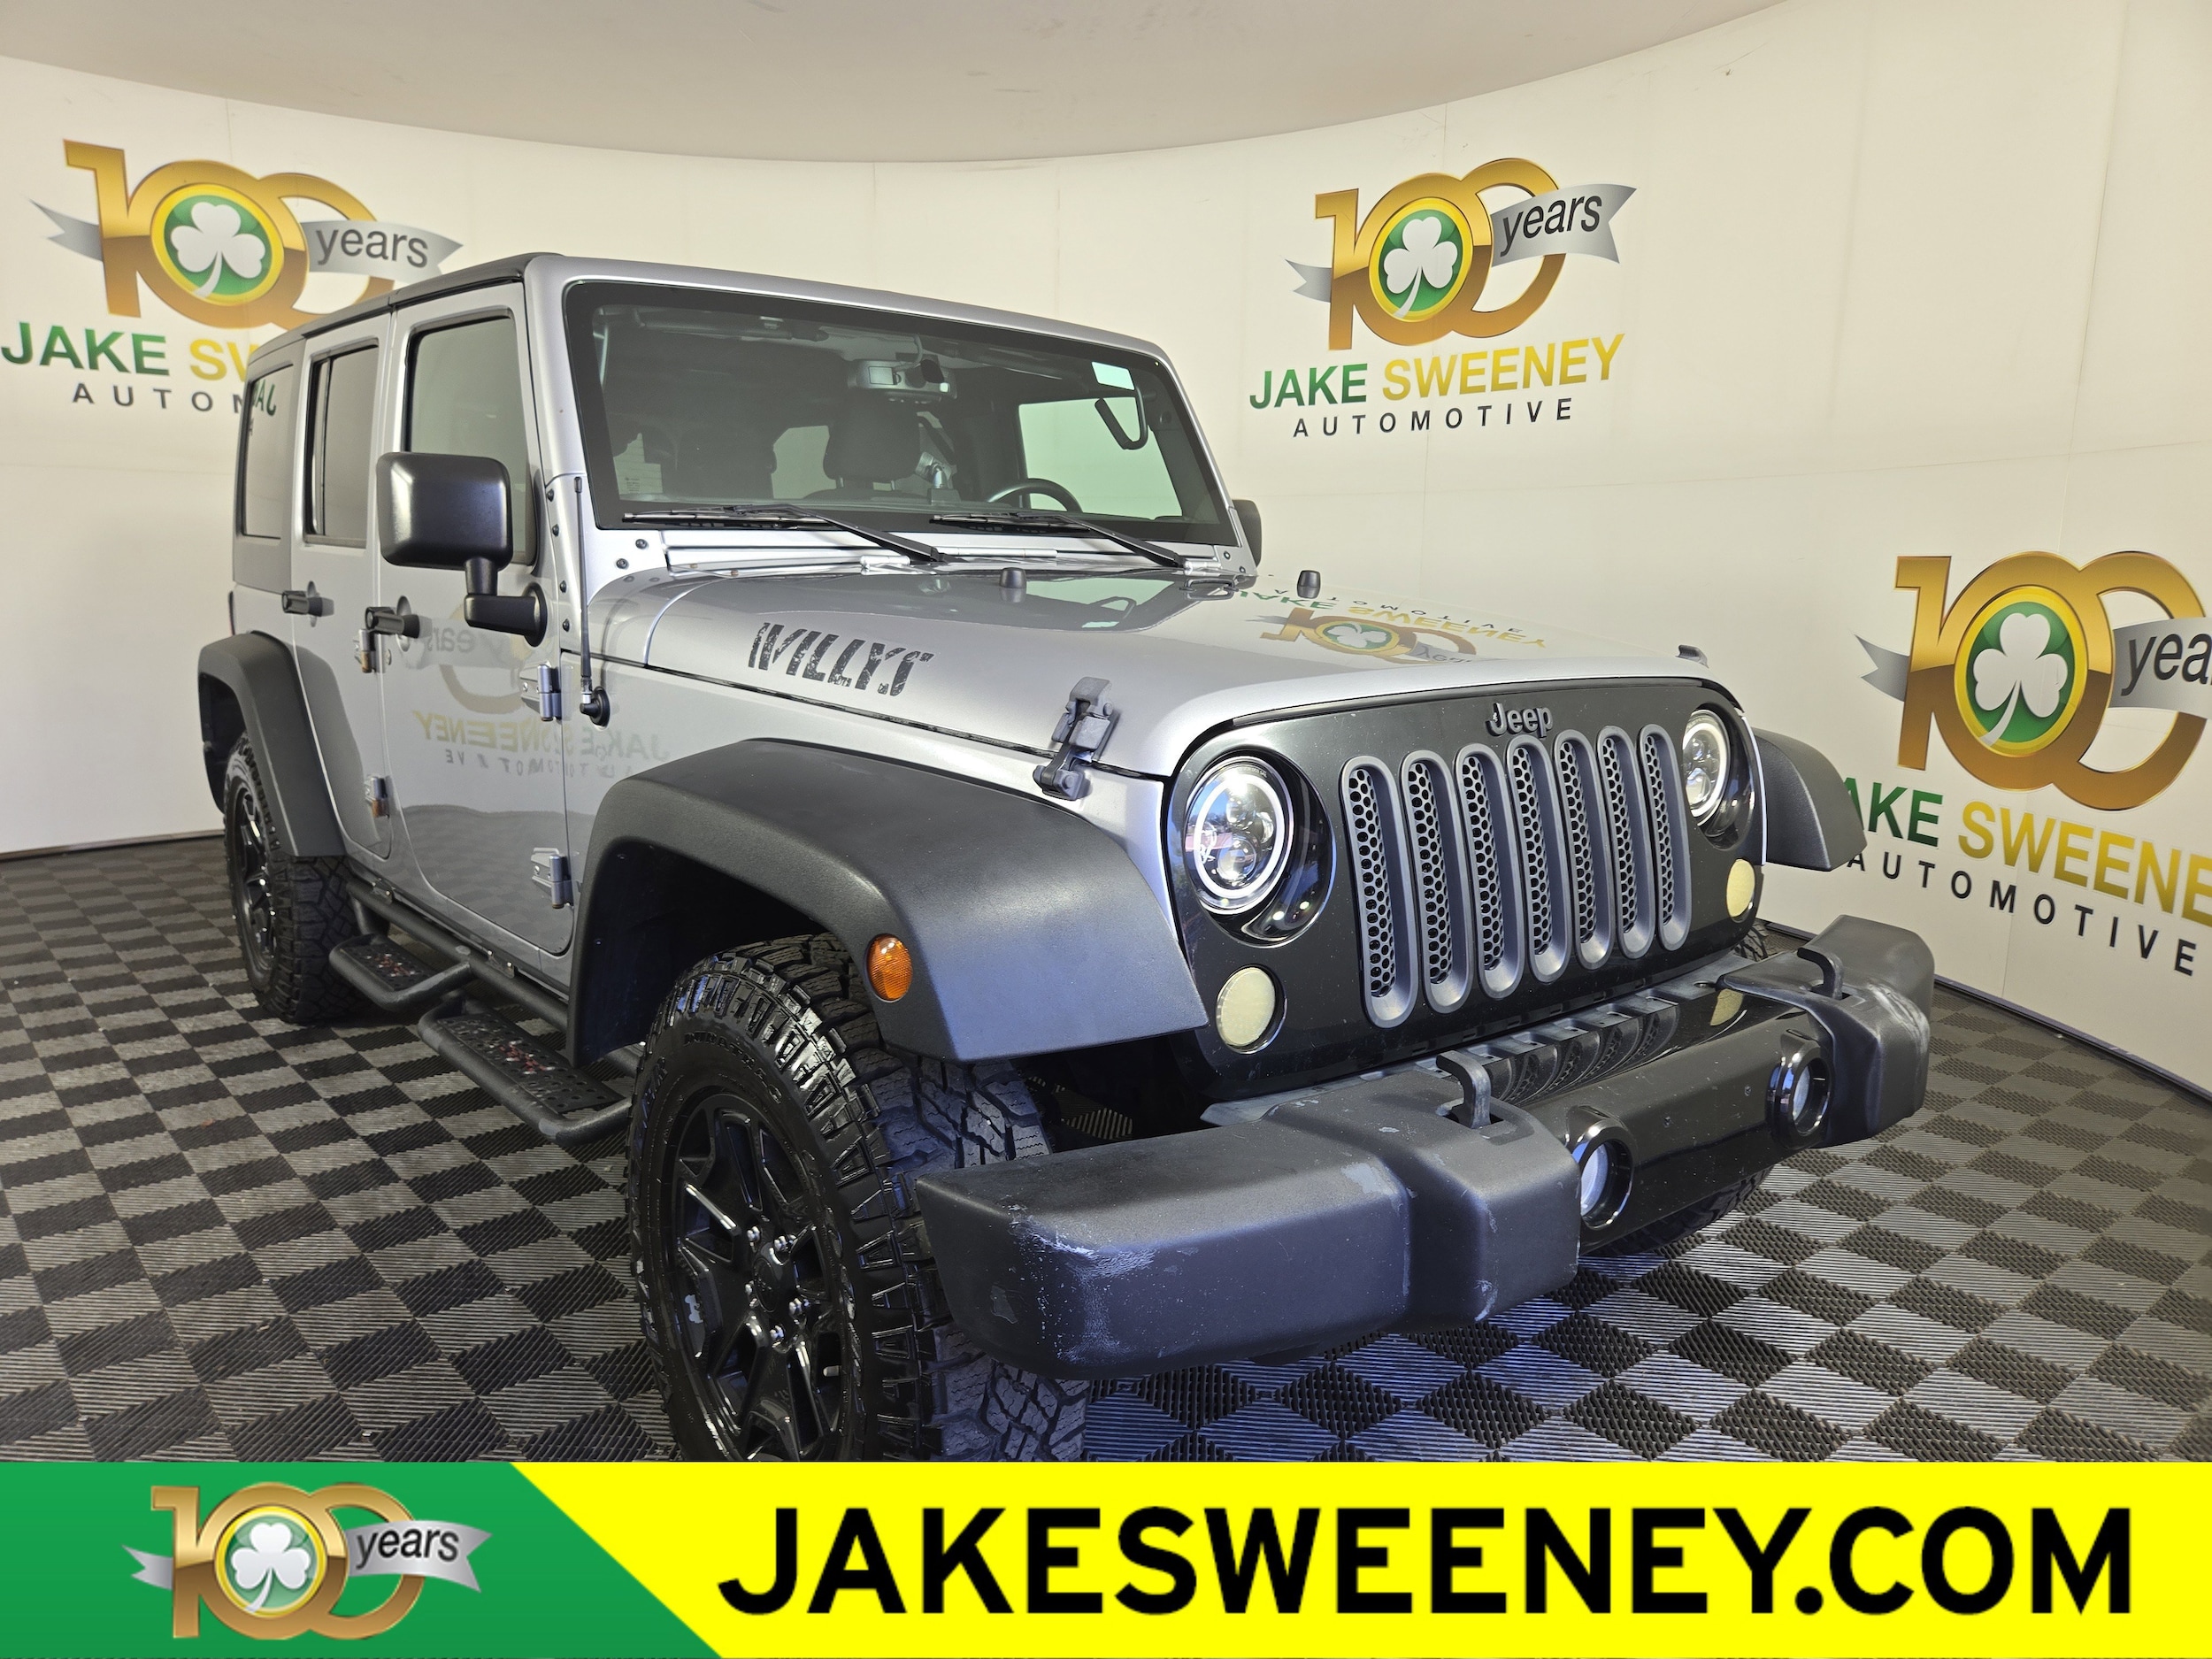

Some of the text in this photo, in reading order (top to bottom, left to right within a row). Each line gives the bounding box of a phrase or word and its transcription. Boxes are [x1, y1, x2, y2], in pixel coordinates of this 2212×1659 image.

[315, 222, 429, 268] years
[1500, 192, 1603, 257] years
[1, 322, 170, 376] JAKE
[1249, 334, 1625, 410] JAKE SWEENEY
[1293, 397, 1572, 438] AUTOMOTIVE
[748, 622, 935, 697] WILLYS
[2121, 631, 2212, 697] yea
[1486, 703, 1554, 738] Jeep
[1847, 851, 2198, 976] AUTOMOTIVE
